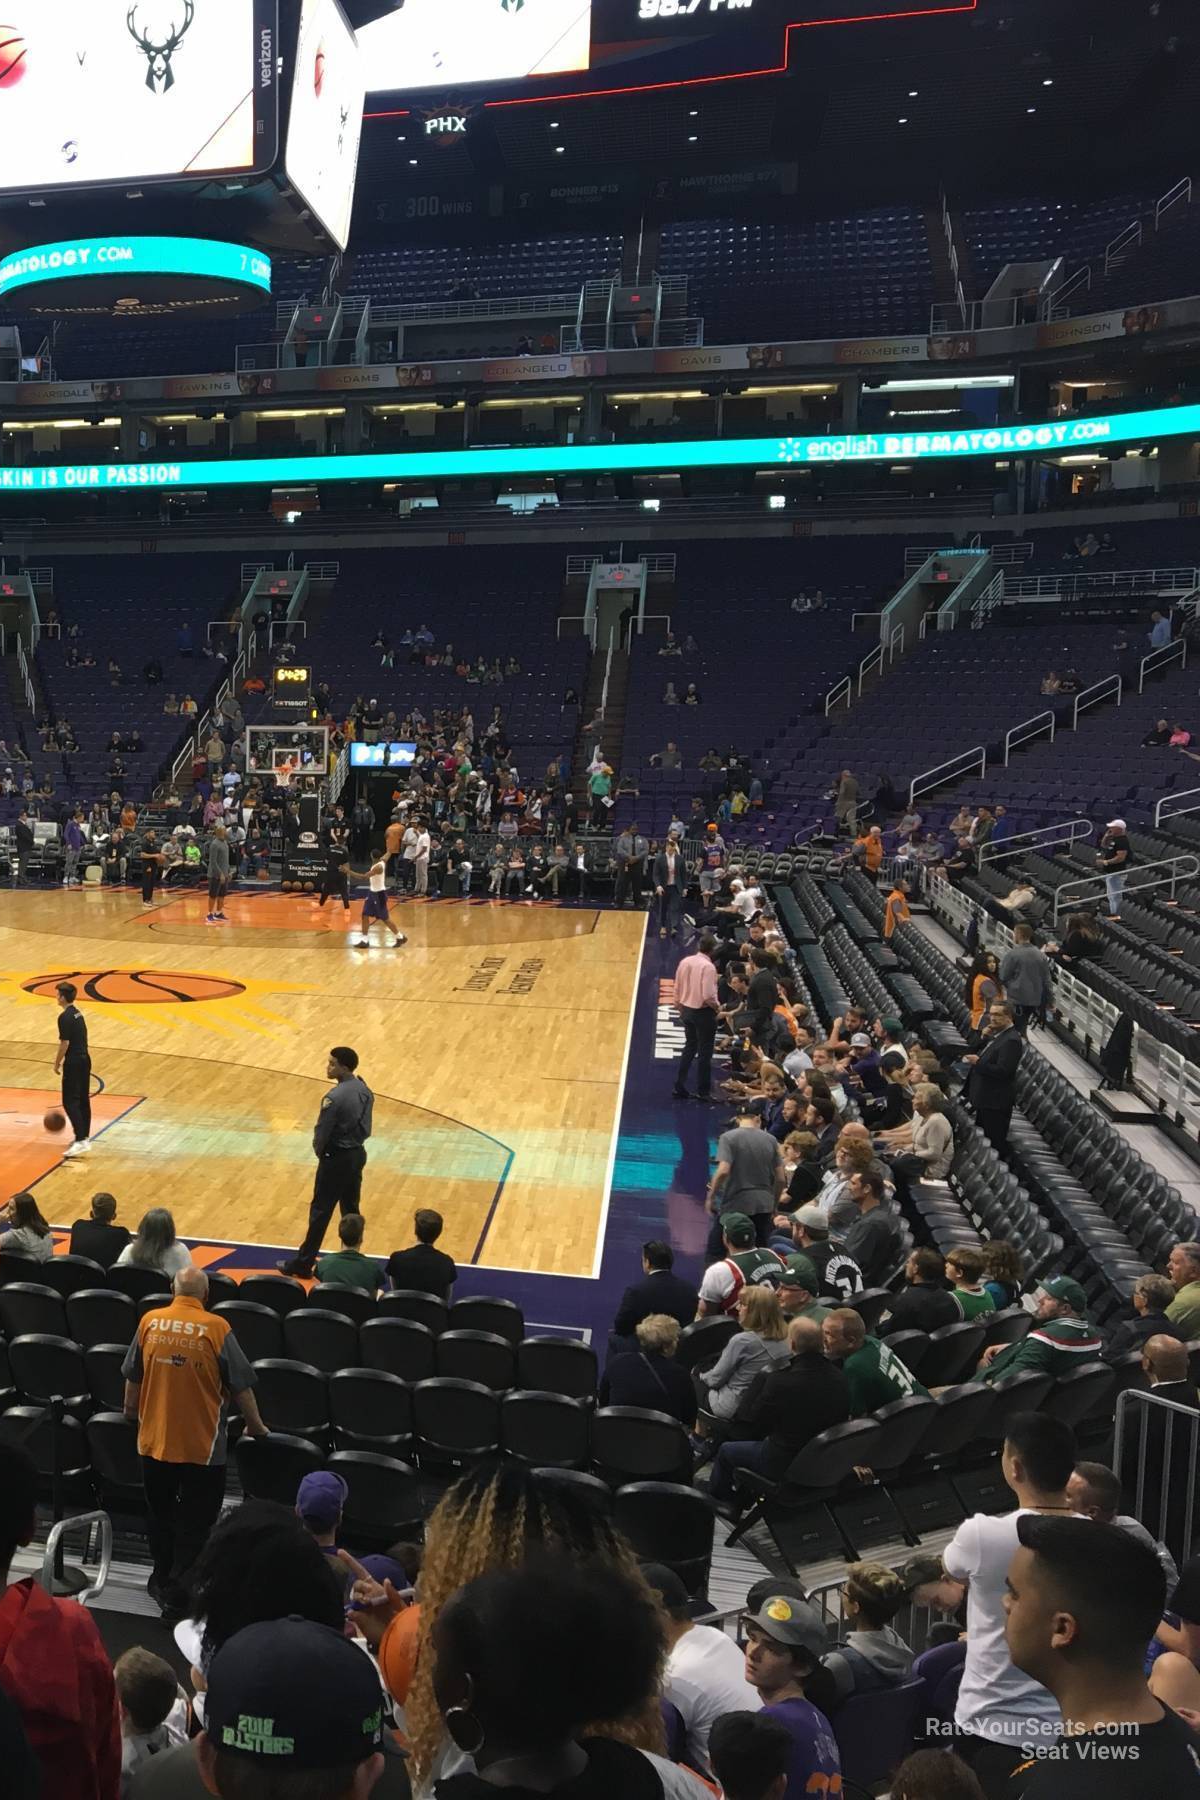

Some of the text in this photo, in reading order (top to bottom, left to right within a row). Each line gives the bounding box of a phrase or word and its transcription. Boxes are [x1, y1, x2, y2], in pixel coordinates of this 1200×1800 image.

[259, 29, 271, 88] verizon
[425, 116, 466, 134] PHX
[406, 196, 473, 218] 300 WINS
[807, 435, 879, 460] english
[41, 467, 57, 486] IS
[65, 466, 100, 485] OUR
[107, 464, 181, 484] PASSION
[148, 1318, 209, 1337] GUEST
[146, 1334, 204, 1351] SERVICES
